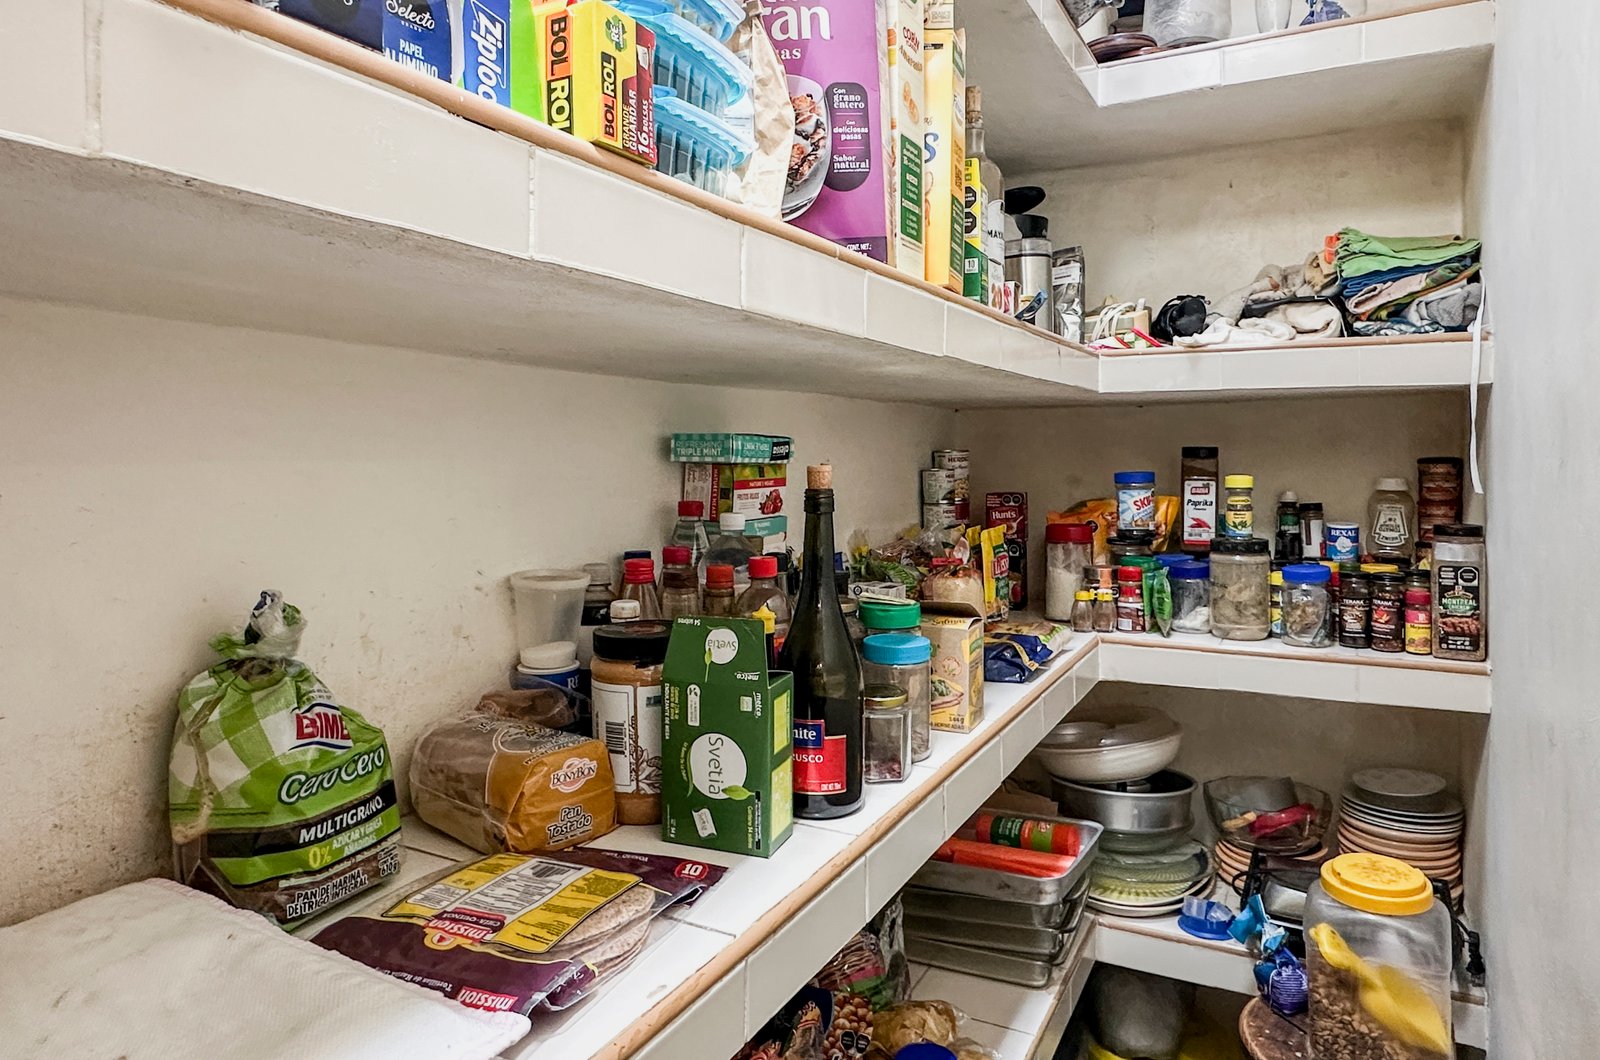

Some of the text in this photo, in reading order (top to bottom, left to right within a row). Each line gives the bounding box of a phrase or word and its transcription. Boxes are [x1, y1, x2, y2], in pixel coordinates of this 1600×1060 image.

[386, 0, 436, 31] Selecto
[400, 38, 425, 59] PAPEL
[550, 16, 570, 130] BOL ROL
[604, 58, 615, 138] BOL ROL
[834, 94, 861, 103] grano
[834, 100, 865, 109] entero
[629, 89, 637, 151] GUARDAR
[638, 131, 649, 154] 16
[833, 154, 856, 162] Sabor
[834, 159, 870, 169] natural
[676, 448, 701, 456] TRIPLE
[1187, 499, 1213, 508] Paprika
[1442, 598, 1477, 606] MONTREAL
[707, 639, 736, 651] Svetia
[708, 736, 724, 795] Svetia
[793, 754, 824, 763] USCO
[280, 746, 385, 803] Cero Cero
[299, 795, 383, 844] MULTIGRANO
[561, 806, 582, 822] Pan
[547, 814, 592, 839] Tostado
[309, 846, 332, 868] 0%
[682, 864, 703, 876] 10
[296, 870, 364, 903] PAN DE HARINA
[288, 876, 368, 919] DE TRIGO INTEGRAL
[428, 920, 488, 939] mission
[422, 978, 453, 992] Tortillas
[458, 989, 513, 1010] mission
